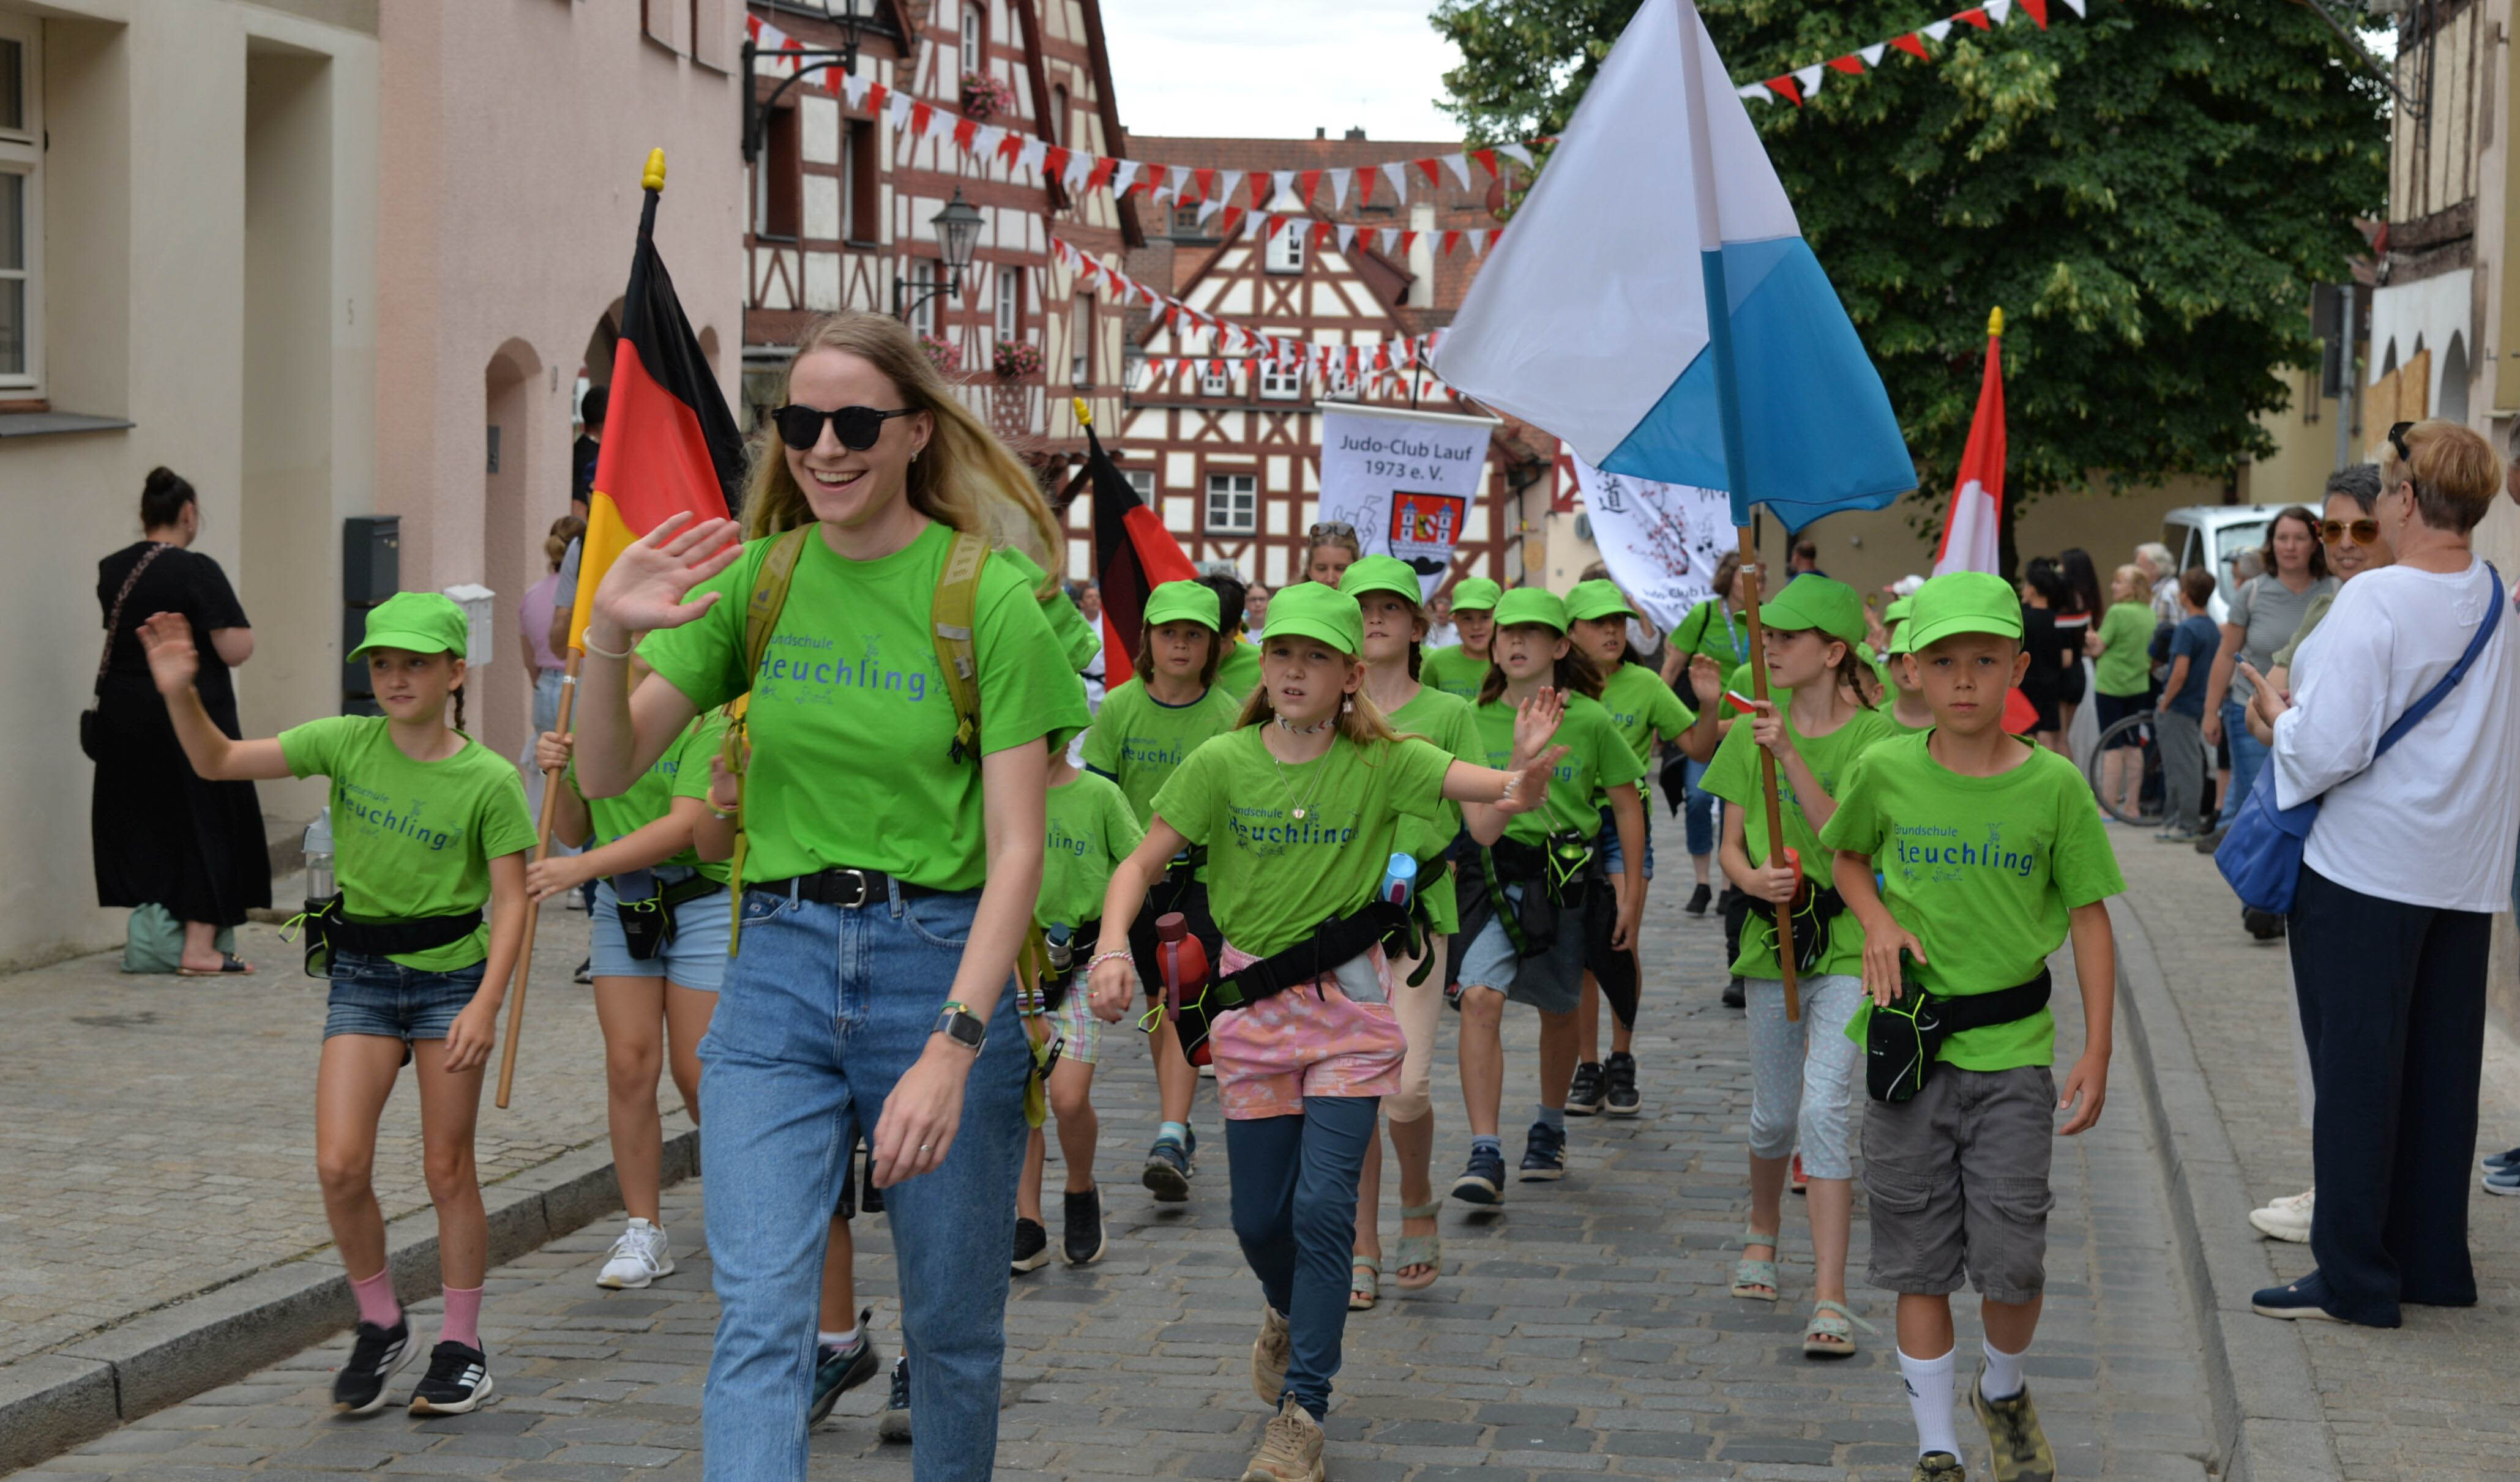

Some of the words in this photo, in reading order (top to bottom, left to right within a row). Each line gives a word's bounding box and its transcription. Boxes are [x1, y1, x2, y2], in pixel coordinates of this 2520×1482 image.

[1340, 433, 1429, 458] Judo-Club
[1434, 443, 1473, 461] Lauf
[1365, 460, 1406, 478] 1973
[1410, 467, 1424, 480] e.
[1429, 465, 1444, 481] V.
[769, 633, 833, 650] undschule
[1894, 823, 1958, 837] Grundschule
